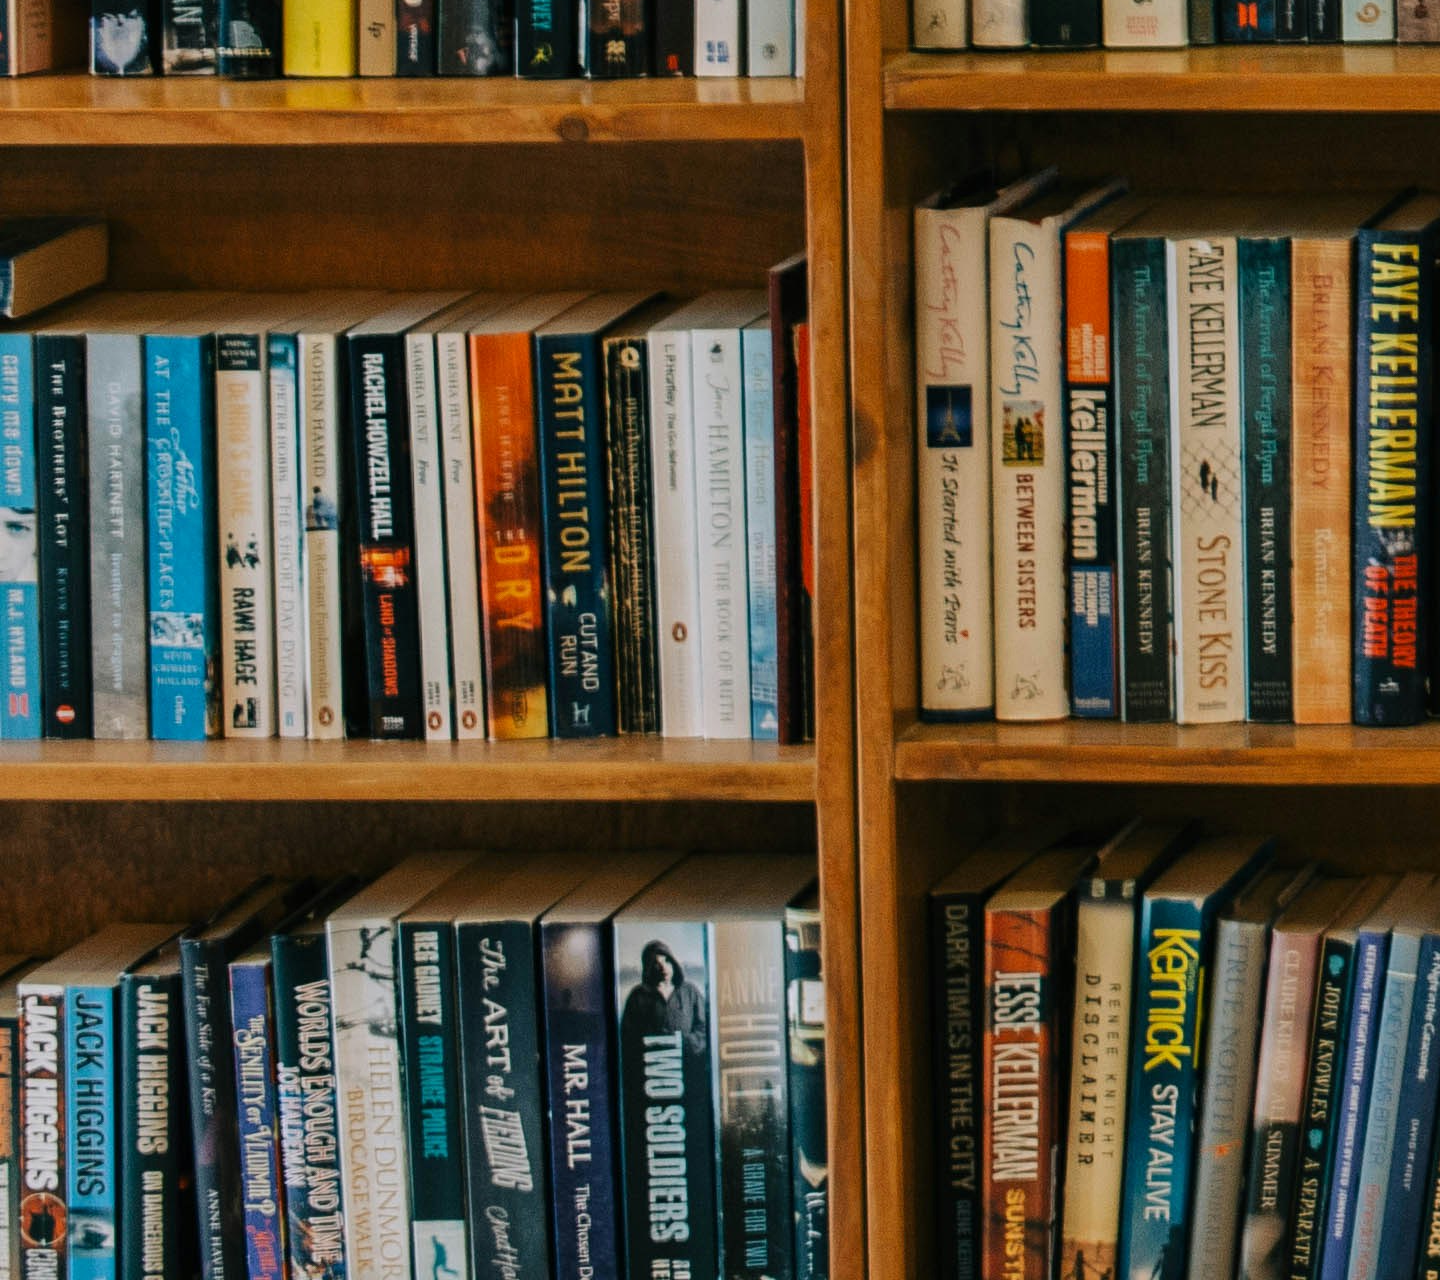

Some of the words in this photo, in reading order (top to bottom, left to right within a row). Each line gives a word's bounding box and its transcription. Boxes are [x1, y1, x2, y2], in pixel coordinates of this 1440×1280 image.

[1367, 244, 1419, 322] FAYE
[359, 354, 385, 417] RACHEL
[551, 352, 588, 446] MATT
[363, 422, 389, 496] HOWZELL
[1369, 330, 1419, 526] KELLERMAN
[367, 501, 392, 538] HALL
[557, 454, 591, 573] HILTON
[1194, 534, 1228, 622] STONE
[1198, 633, 1232, 690] KISS
[23, 995, 56, 1072] JACK
[73, 995, 105, 1069] JACK
[995, 971, 1042, 1036] JESSE
[1144, 929, 1199, 1070] Kernick
[643, 1032, 681, 1098] TWO
[24, 1079, 58, 1188] HIGGINS
[75, 1079, 107, 1195] HIGGINS
[992, 1042, 1041, 1181] KELLERMAN
[1147, 1084, 1177, 1141] STAY
[646, 1104, 687, 1240] SOLDIERS
[1144, 1149, 1174, 1220] ALIVE
